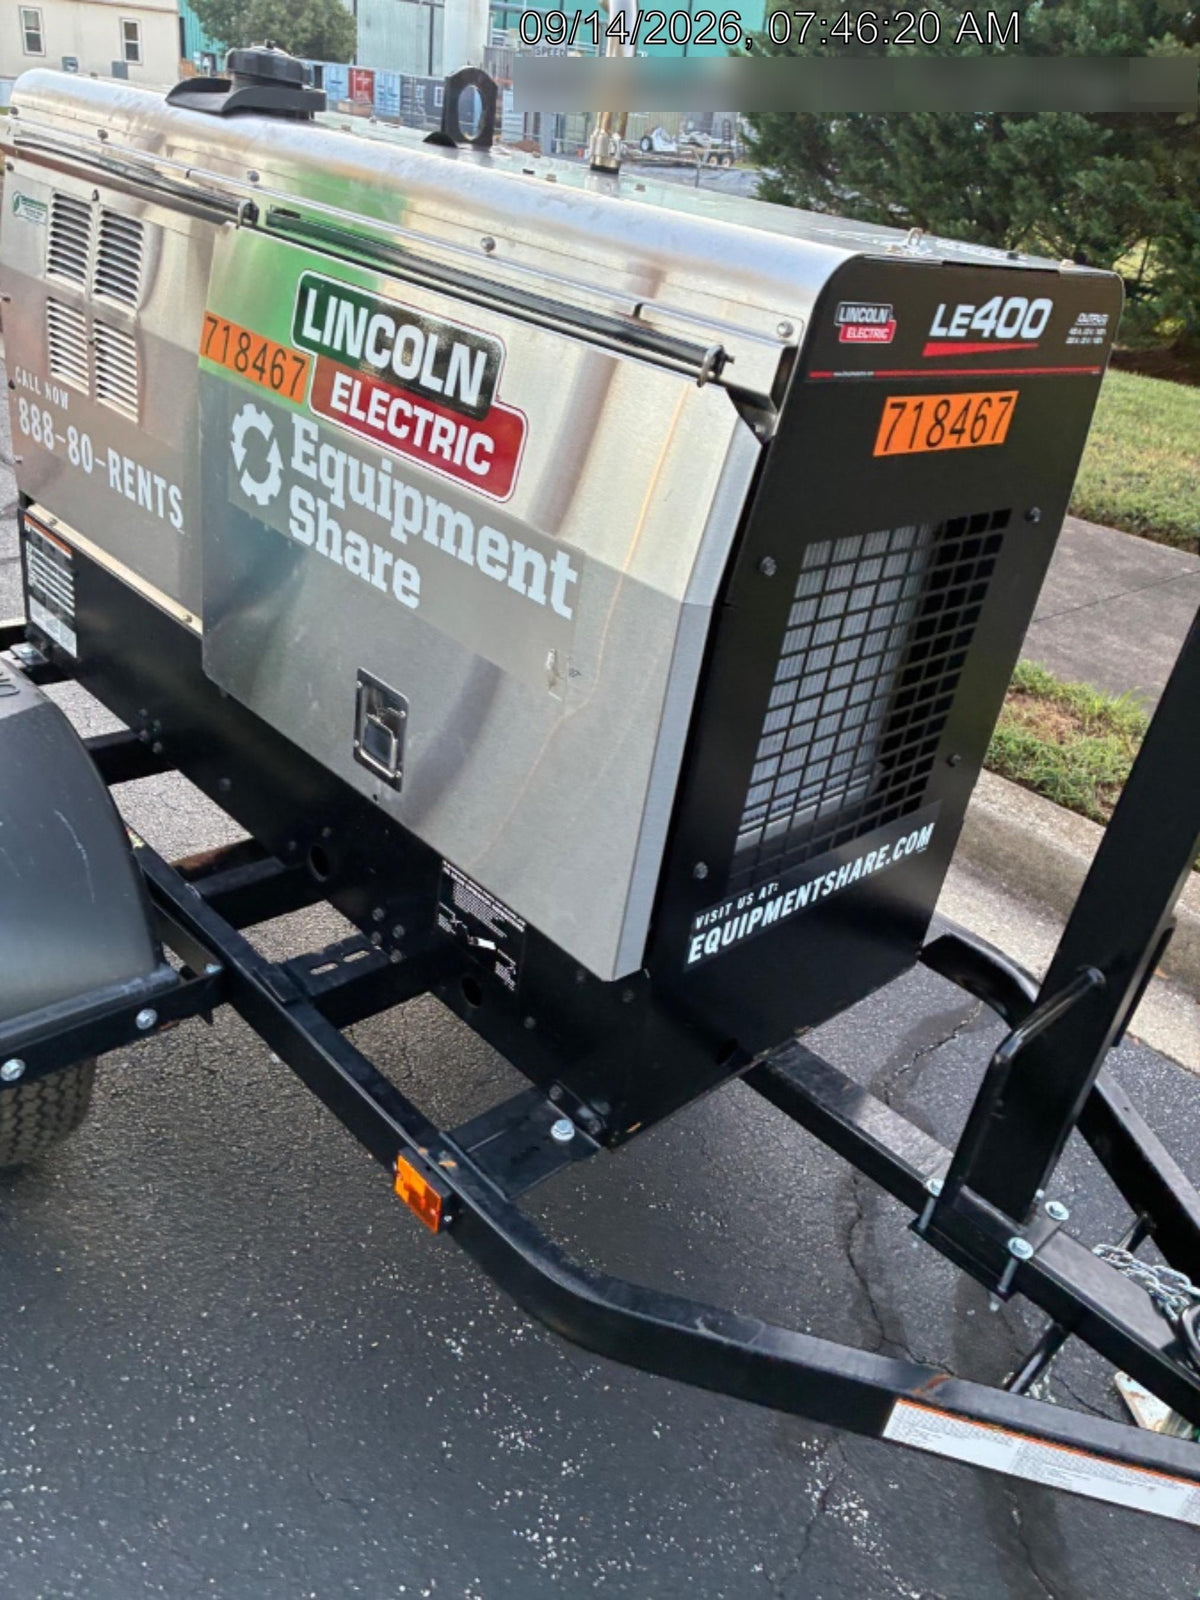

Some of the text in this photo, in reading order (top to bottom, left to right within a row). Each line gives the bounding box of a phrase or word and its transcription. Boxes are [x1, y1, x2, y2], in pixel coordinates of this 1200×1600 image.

[203, 314, 306, 398] 718467
[302, 288, 488, 408] LINCOLN
[838, 306, 890, 324] LINCOLN
[846, 326, 890, 340] ELECTRIC
[929, 296, 1053, 339] LE400
[15, 366, 69, 411] CALL NOW
[329, 371, 495, 477] ELECTRIC
[883, 395, 1014, 452] 718467
[18, 397, 186, 530] 888-80-RENTS
[288, 484, 421, 610] Share
[290, 412, 578, 621] Equipment
[687, 822, 936, 964] EQUIPMENTSHARE.COM
[694, 881, 780, 930] VISIT US AT:
